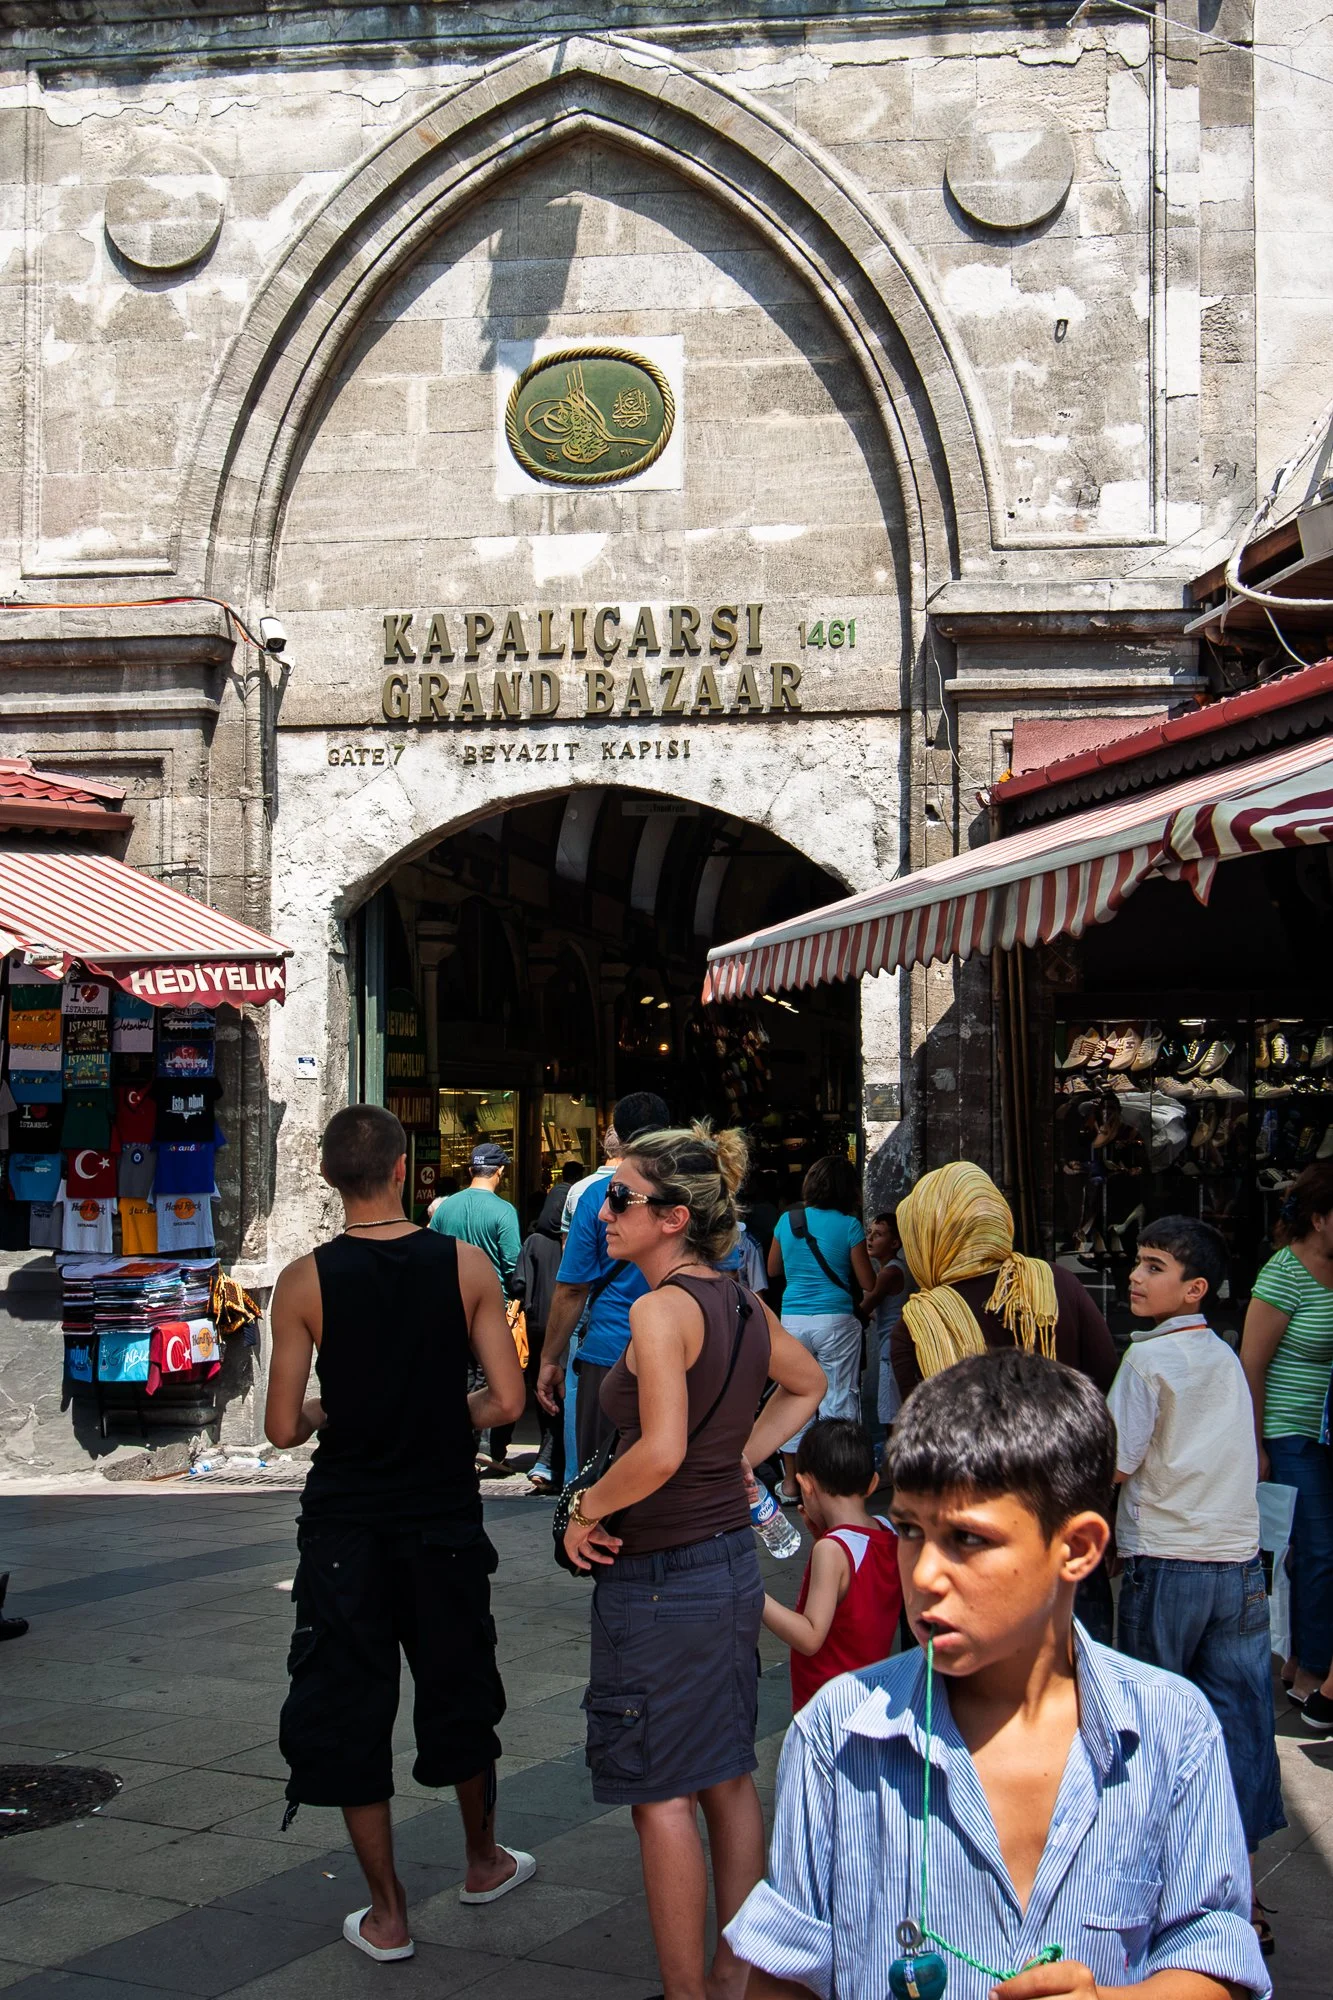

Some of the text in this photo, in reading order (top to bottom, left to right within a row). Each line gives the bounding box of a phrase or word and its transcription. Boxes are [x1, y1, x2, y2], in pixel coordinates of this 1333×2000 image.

[383, 603, 763, 672] KAPALIÇARŞI
[798, 618, 857, 648] 1461
[382, 662, 803, 719] GRAND BAZAAR
[327, 744, 406, 766] GATE 7
[463, 739, 691, 764] BEYAZIT KAPISI
[130, 962, 285, 995] HEDİYELİK
[422, 1170, 434, 1181] 14
